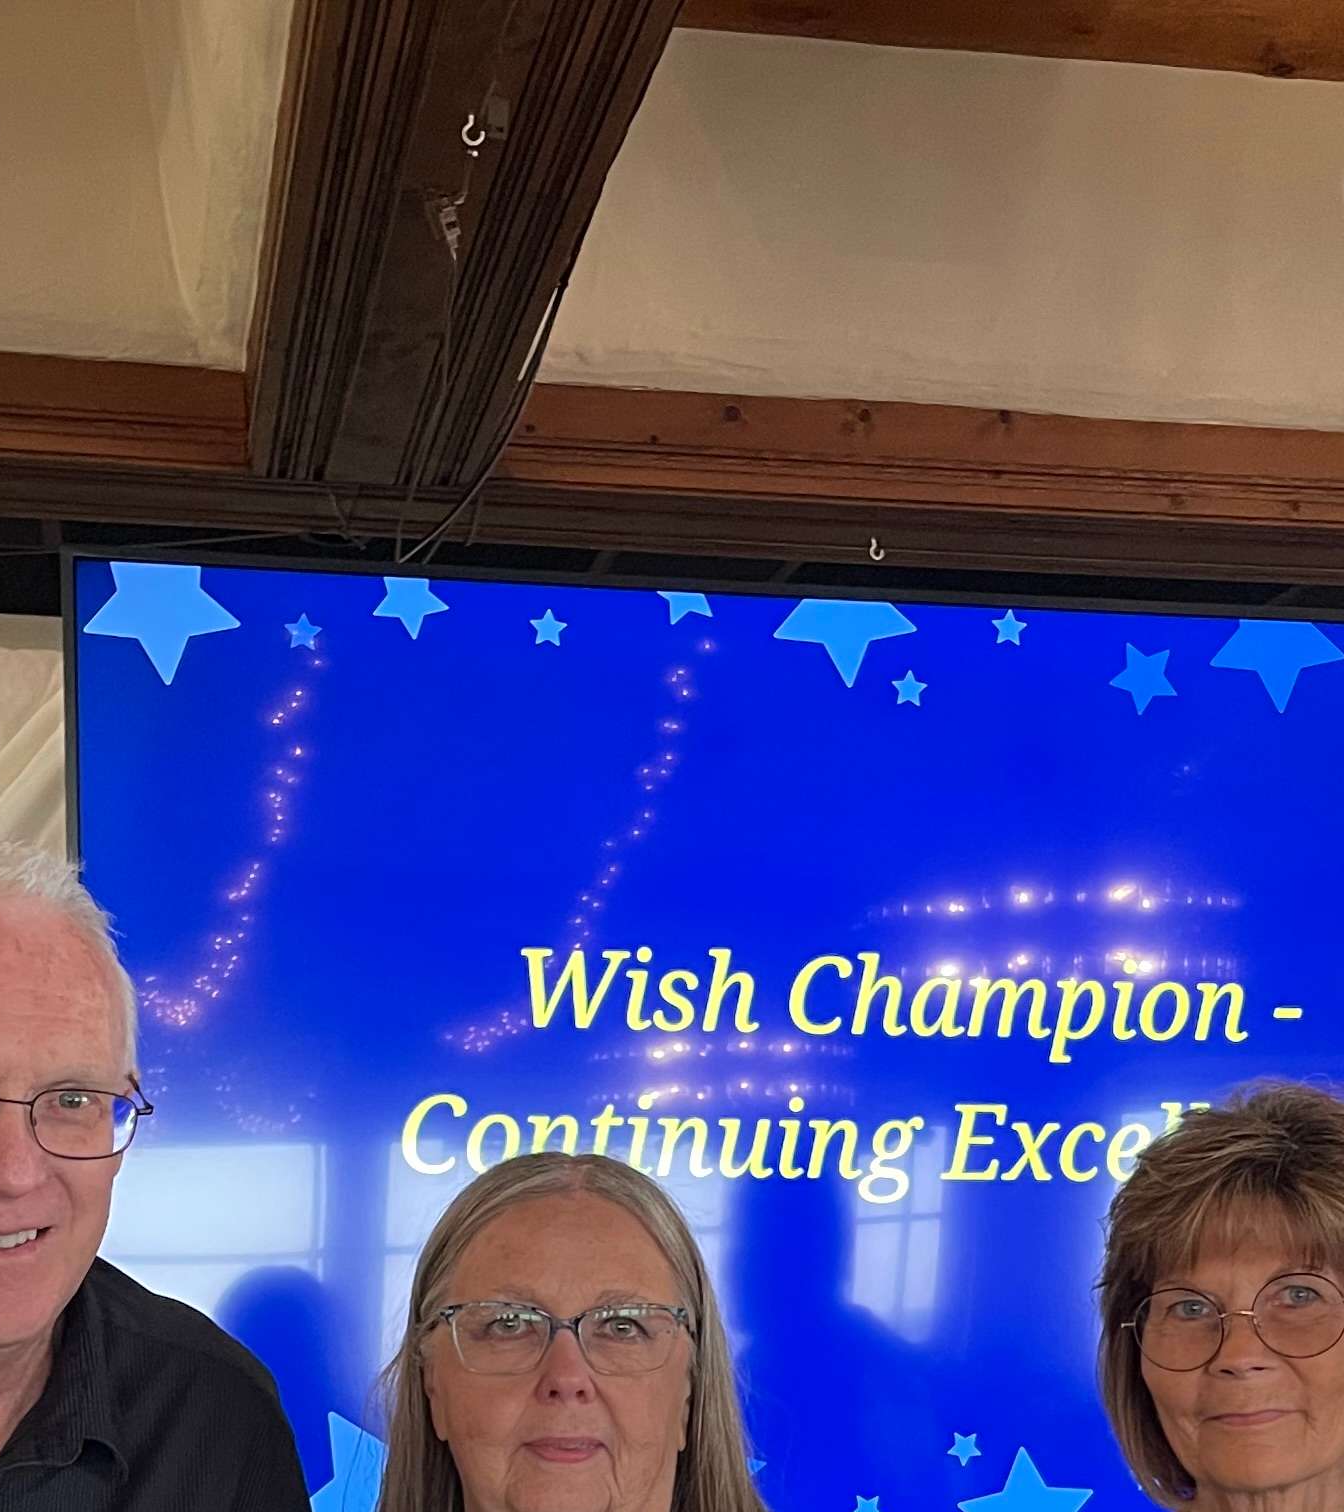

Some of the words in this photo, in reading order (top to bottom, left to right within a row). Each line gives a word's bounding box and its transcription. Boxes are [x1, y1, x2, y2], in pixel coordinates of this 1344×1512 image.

[520, 946, 760, 1033] Wish
[788, 951, 1249, 1063] Champion
[401, 1091, 924, 1204] Continuing
